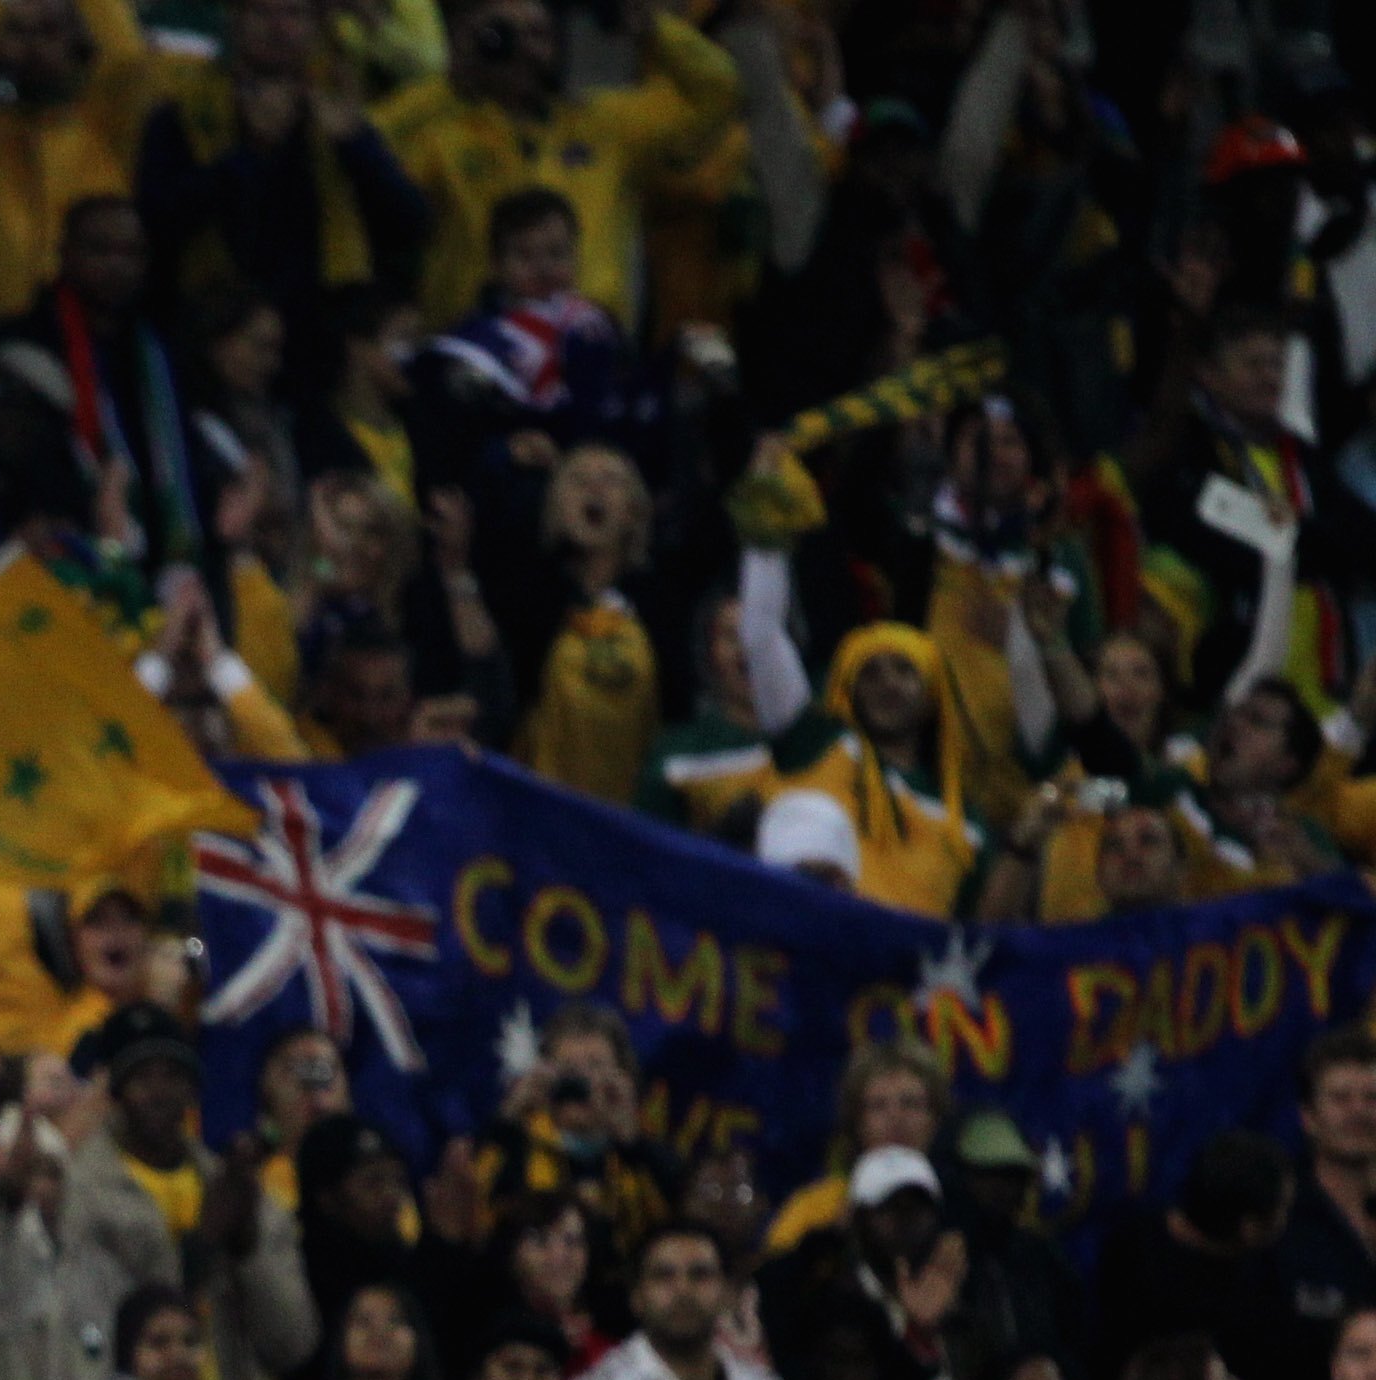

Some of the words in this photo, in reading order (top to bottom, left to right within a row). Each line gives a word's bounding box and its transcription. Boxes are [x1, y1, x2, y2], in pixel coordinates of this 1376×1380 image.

[451, 853, 791, 1059] COME
[847, 984, 1011, 1077] ON
[1065, 914, 1348, 1072] DADDY
